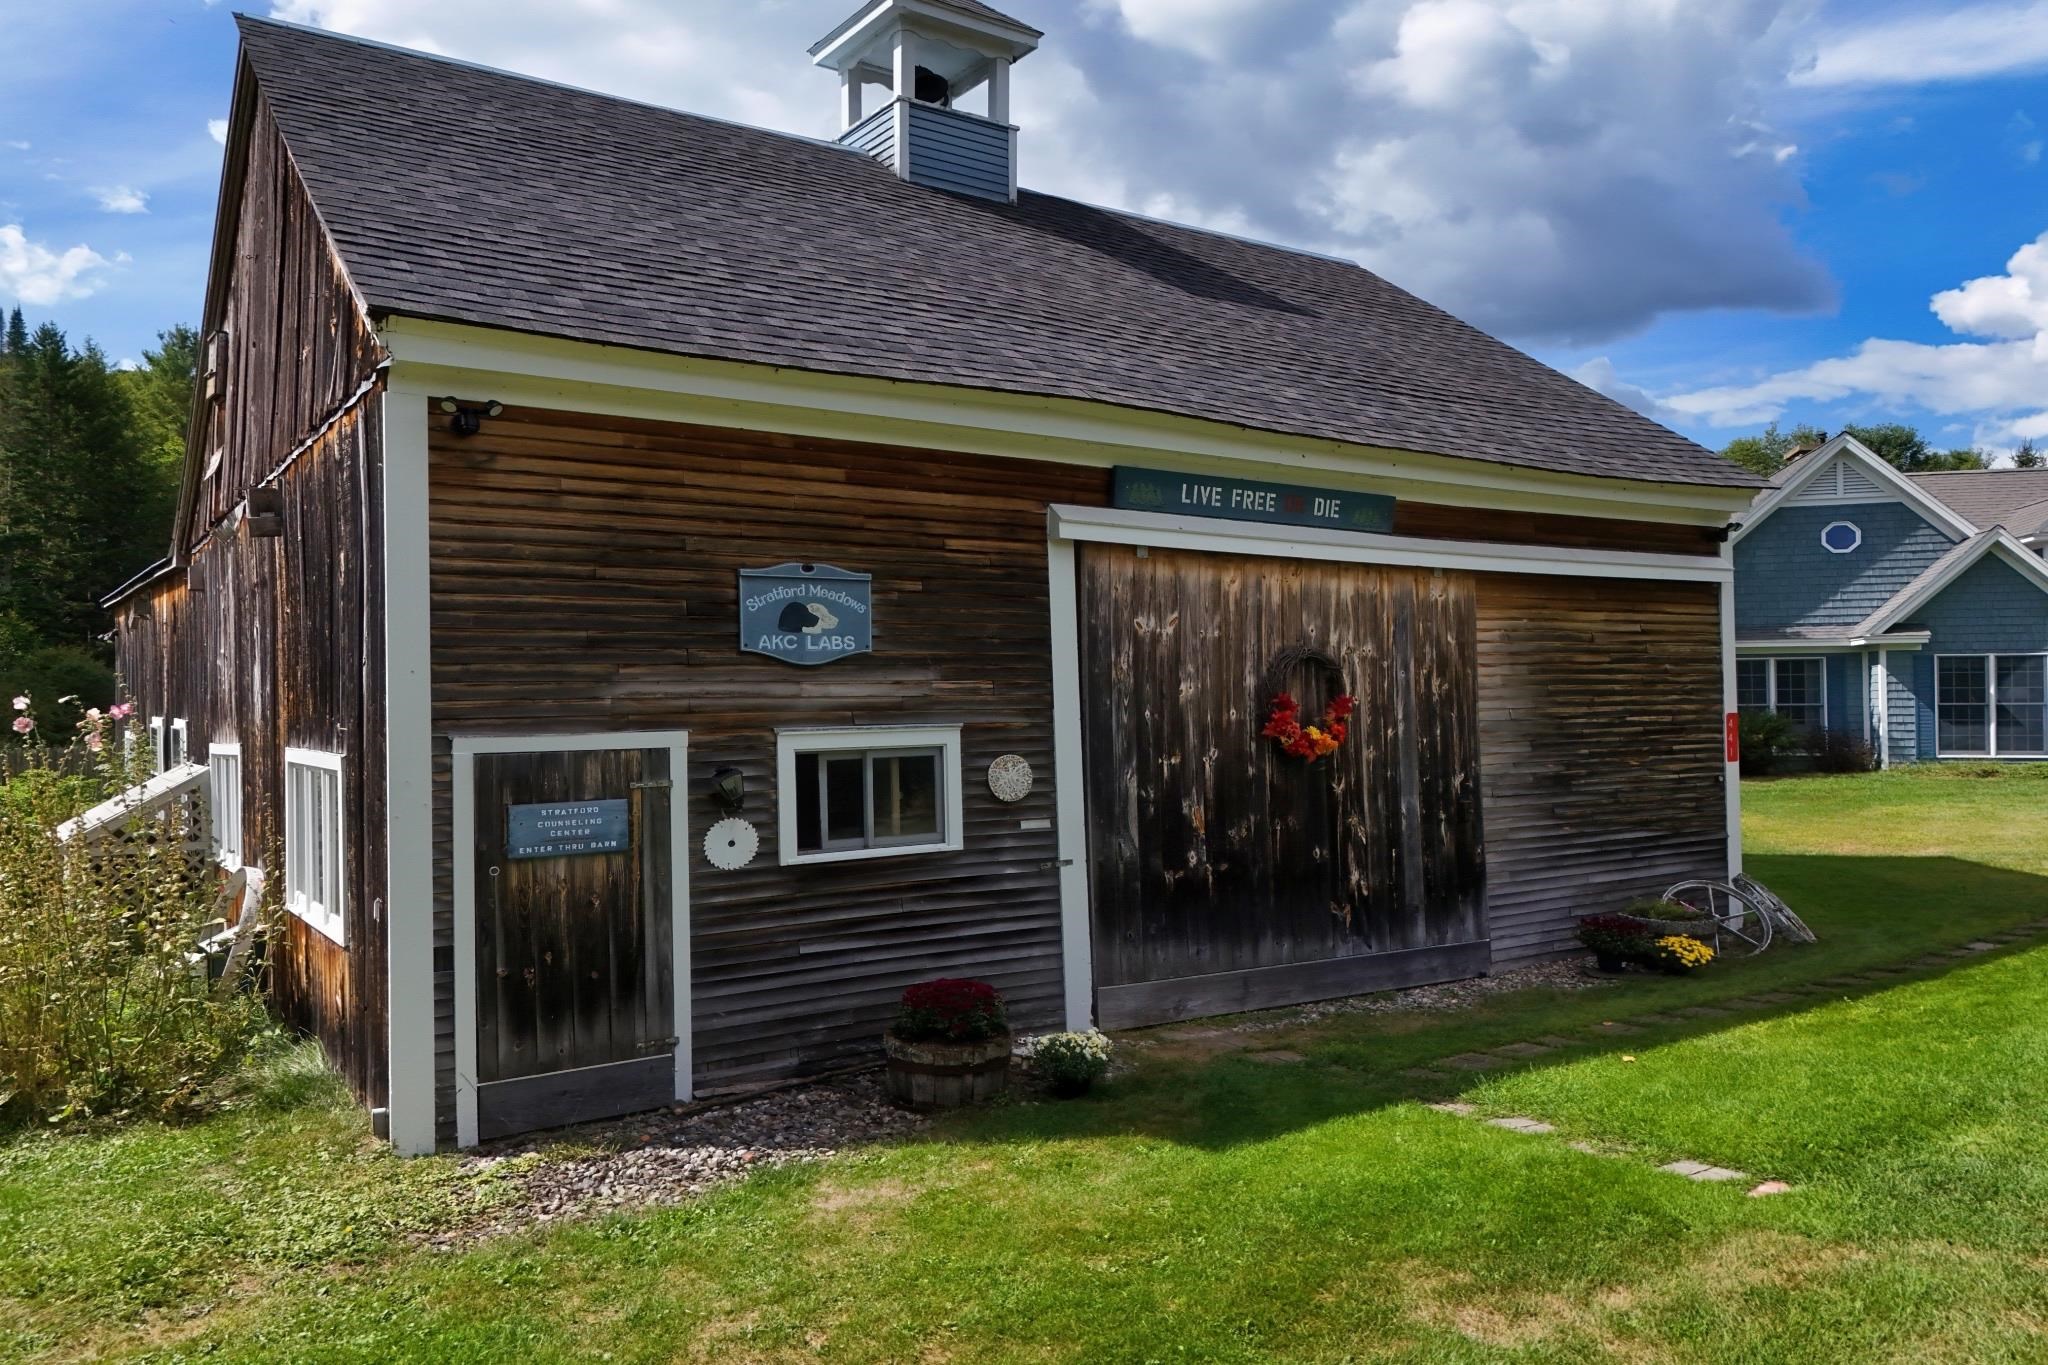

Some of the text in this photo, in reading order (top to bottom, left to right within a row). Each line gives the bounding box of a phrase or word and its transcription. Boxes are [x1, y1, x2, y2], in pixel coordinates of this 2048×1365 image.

[1181, 483, 1222, 507] LIVE
[1231, 489, 1276, 513] FREE
[1313, 497, 1341, 519] DIE
[745, 584, 866, 614] Stratford Meadows
[758, 635, 856, 650] AKC LABS
[541, 806, 599, 816] STRATFORD
[537, 818, 602, 828] COUNSELING
[550, 829, 590, 837] CENTER
[519, 840, 617, 854] ENTER THRU BARN
